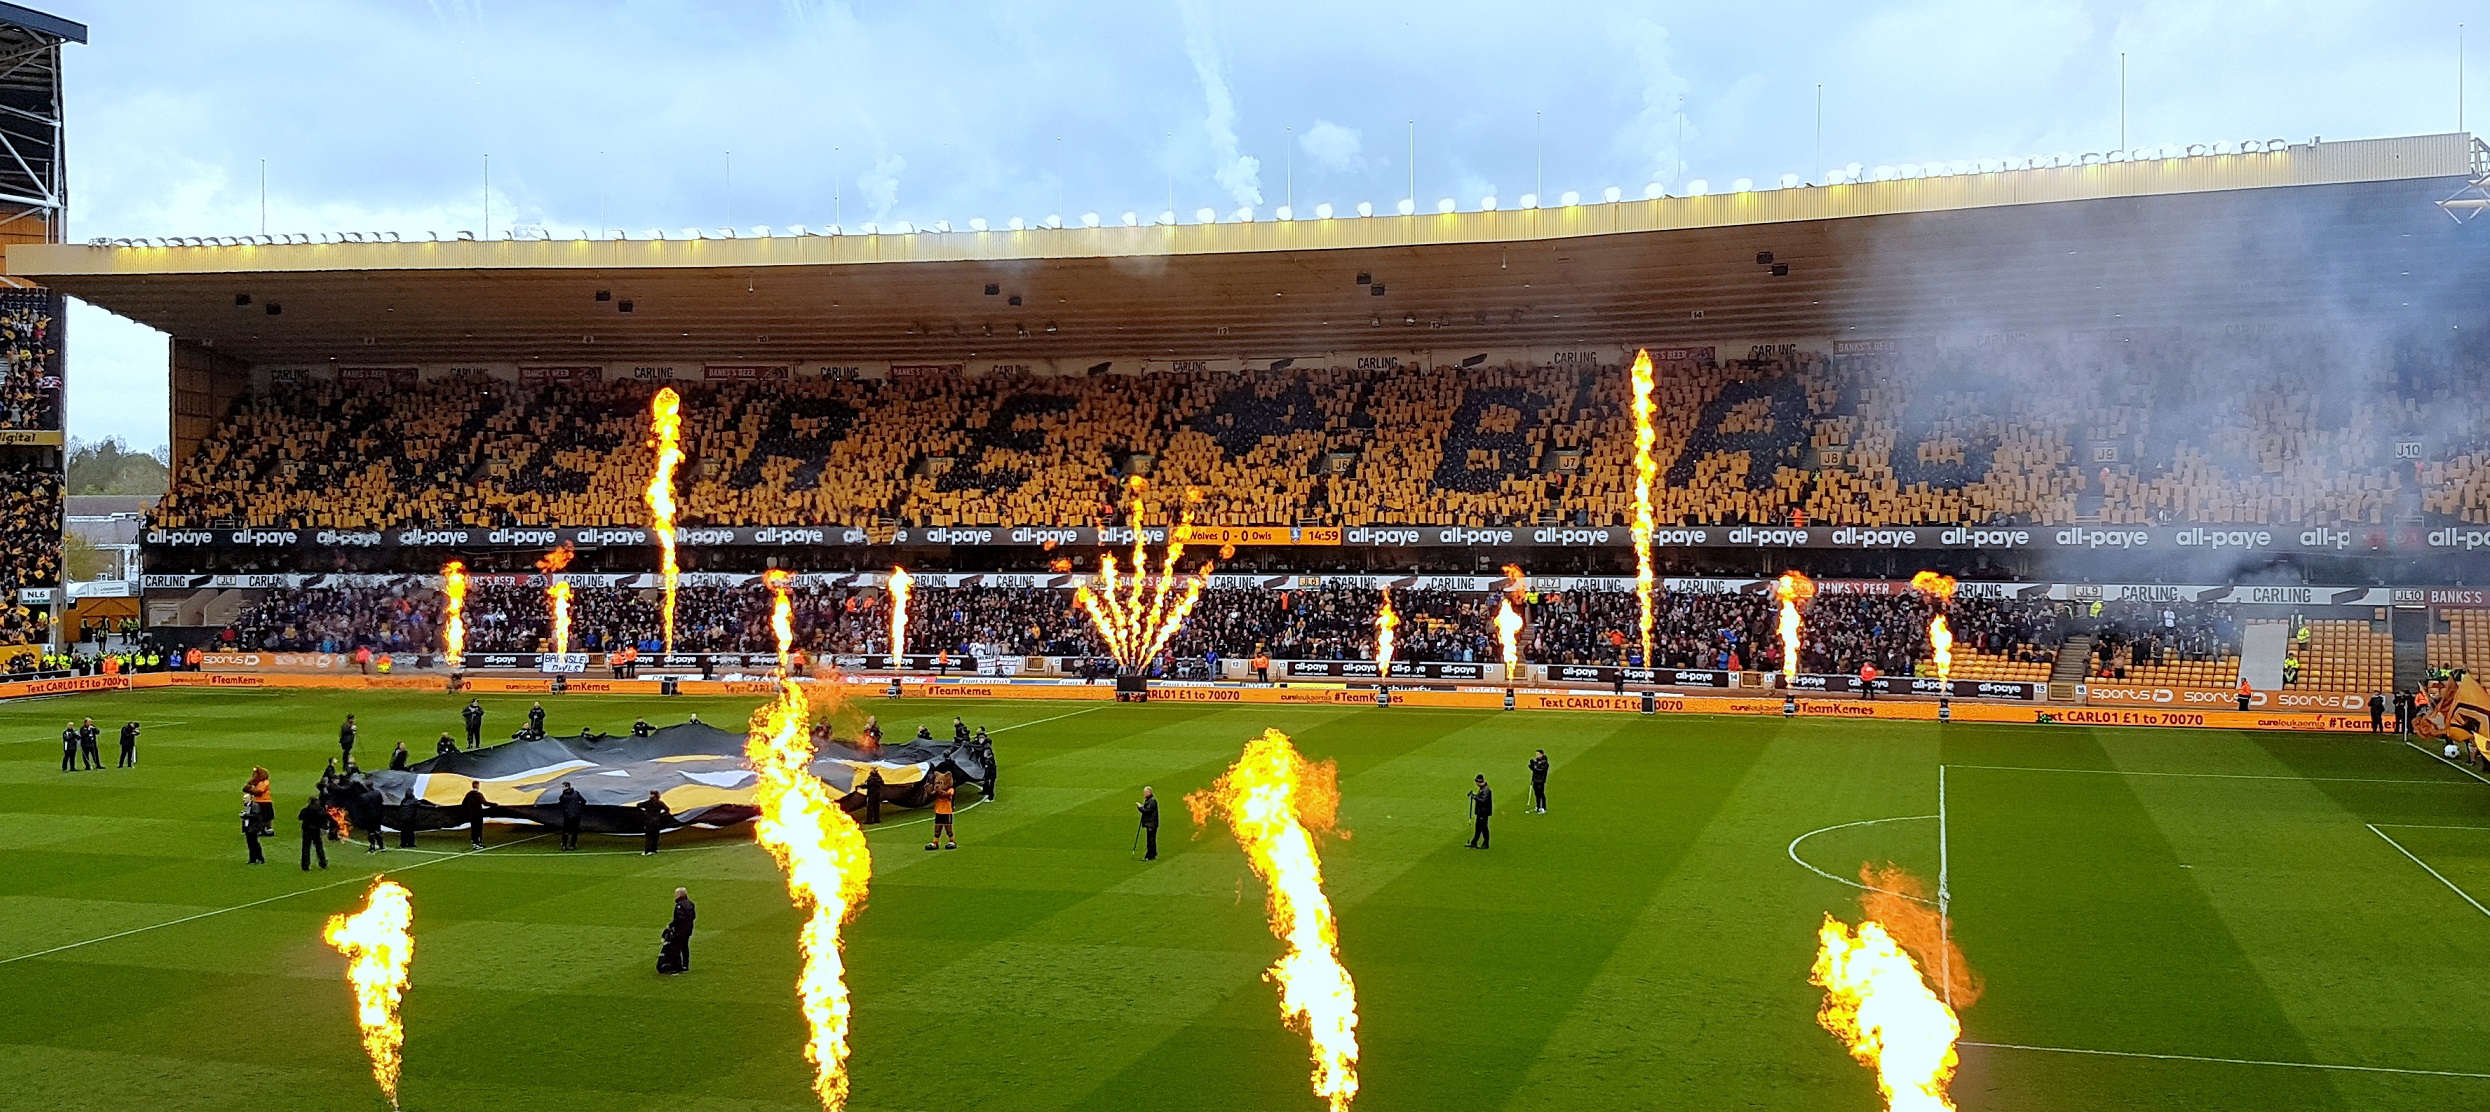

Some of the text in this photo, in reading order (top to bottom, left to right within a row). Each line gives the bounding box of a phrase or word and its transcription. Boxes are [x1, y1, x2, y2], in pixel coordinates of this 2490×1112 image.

[1554, 352, 1597, 364] CARLING
[1667, 350, 1688, 359] BEER
[1173, 361, 1206, 372] CARLING
[1358, 357, 1398, 369] CARLING
[634, 366, 674, 379] CARLING
[820, 366, 859, 378] CARLING
[2098, 448, 2114, 460] J9
[2395, 442, 2420, 458] J10
[1336, 460, 1348, 470] J6
[1562, 457, 1576, 468] J7
[1823, 453, 1839, 465] J8
[146, 529, 213, 547] all-paye
[232, 529, 298, 546] all-paye
[488, 528, 557, 546] all-paye
[577, 528, 646, 546] all-paye
[754, 527, 824, 546] all-paye
[926, 527, 992, 546] all-paye
[1012, 527, 1078, 545] all-paye
[1190, 531, 1218, 540] Wolves
[1222, 530, 1230, 541] 0
[1241, 531, 1249, 541] 0
[1252, 532, 1272, 540] Owls
[1308, 531, 1338, 541] 14:59
[1348, 527, 1420, 546] all-paye
[1440, 527, 1513, 546] all-paye
[1534, 527, 1609, 546] all-paye
[1728, 527, 1809, 547] all-paye
[1832, 527, 1916, 547] all-paye
[1940, 527, 2029, 548] all-paye
[2055, 527, 2149, 548] all-paye
[2176, 527, 2272, 549] all-paye
[145, 575, 186, 587] CARLING
[494, 575, 516, 586] BEER
[563, 575, 604, 588] CARLING
[690, 574, 731, 587] CARLING
[788, 575, 823, 587] ARLING
[996, 575, 1035, 588] CARLING
[1214, 576, 1255, 588] CARLING
[1431, 577, 1475, 590] CARLING
[1541, 578, 1556, 588] JL7
[1575, 578, 1621, 592] CARLING
[1678, 580, 1725, 594] CARLING
[1818, 583, 1860, 595] BANKS'S
[2078, 587, 2098, 596] JL9
[27, 590, 45, 598] NL6
[2121, 586, 2178, 601] CARLING
[2253, 588, 2311, 603] CARLING
[2398, 591, 2422, 600] JL10
[2431, 591, 2483, 604] BANKS'S
[484, 655, 516, 664] all-paye
[1295, 662, 1328, 672] all-paye
[1343, 663, 1377, 674] all-paye
[1441, 665, 1477, 675] all-paye
[1562, 667, 1599, 678] all-paye
[1675, 671, 1713, 682] all-paye
[26, 684, 45, 694] Text
[47, 681, 78, 692] CARL01
[80, 680, 90, 691] £1
[91, 679, 100, 688] to
[929, 686, 992, 696] #TeamKemes
[1978, 682, 2022, 693] all-paye
[1179, 690, 1192, 700] £1
[1194, 690, 1206, 700] to
[1208, 690, 1240, 700] 70070
[2091, 688, 2150, 703] sports
[2278, 694, 2341, 707] sports
[1539, 697, 1564, 708] Text
[1567, 698, 1610, 709] CARL01
[1614, 698, 1628, 709] £1
[1655, 700, 1683, 710] 0070
[2068, 711, 2118, 722] CARL01
[2124, 712, 2139, 723] £1
[2143, 713, 2157, 723] to
[2162, 714, 2204, 725] 70070
